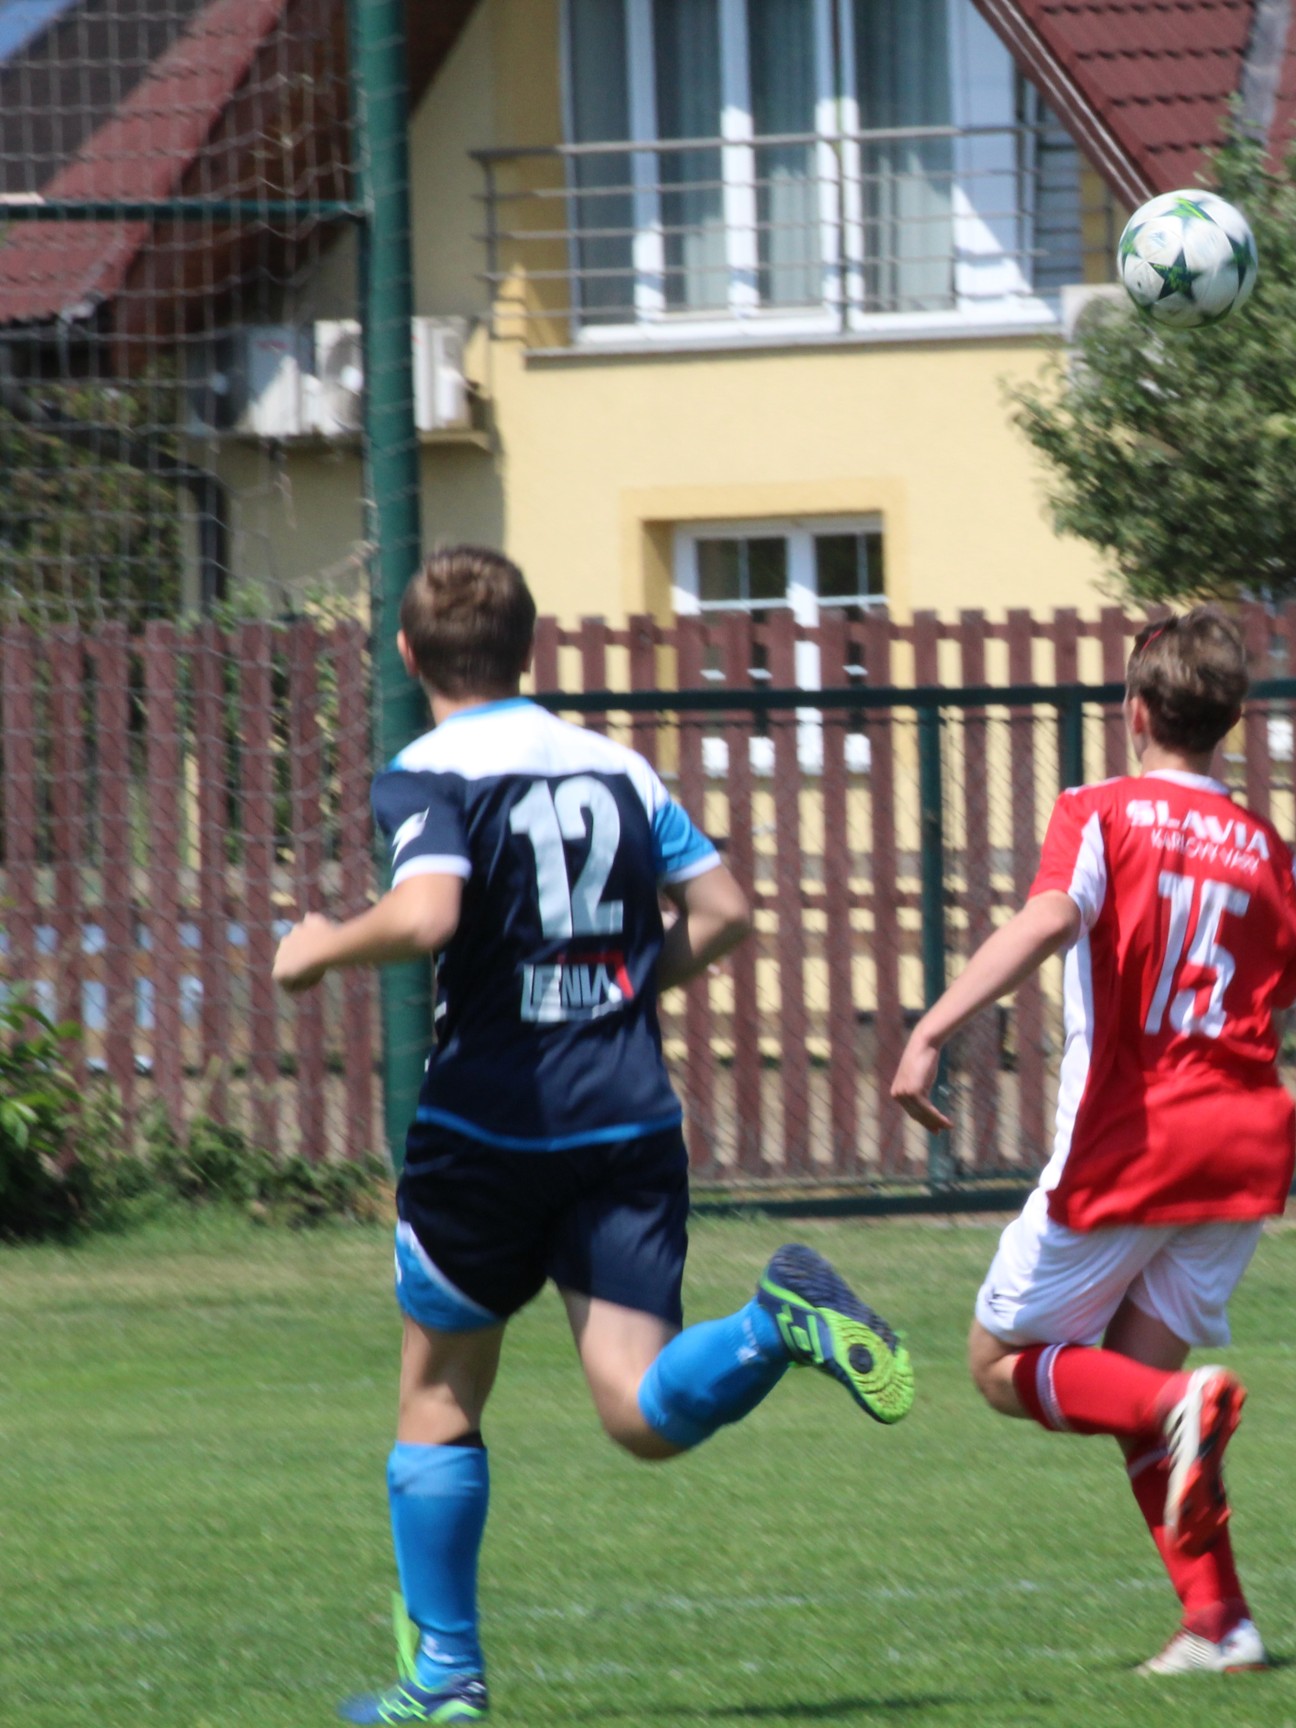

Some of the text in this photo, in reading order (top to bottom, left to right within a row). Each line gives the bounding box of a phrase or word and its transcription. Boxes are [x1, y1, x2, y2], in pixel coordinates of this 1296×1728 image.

[508, 774, 624, 939] 12
[1126, 799, 1270, 861] SLAVIA
[1144, 869, 1251, 1040] 15
